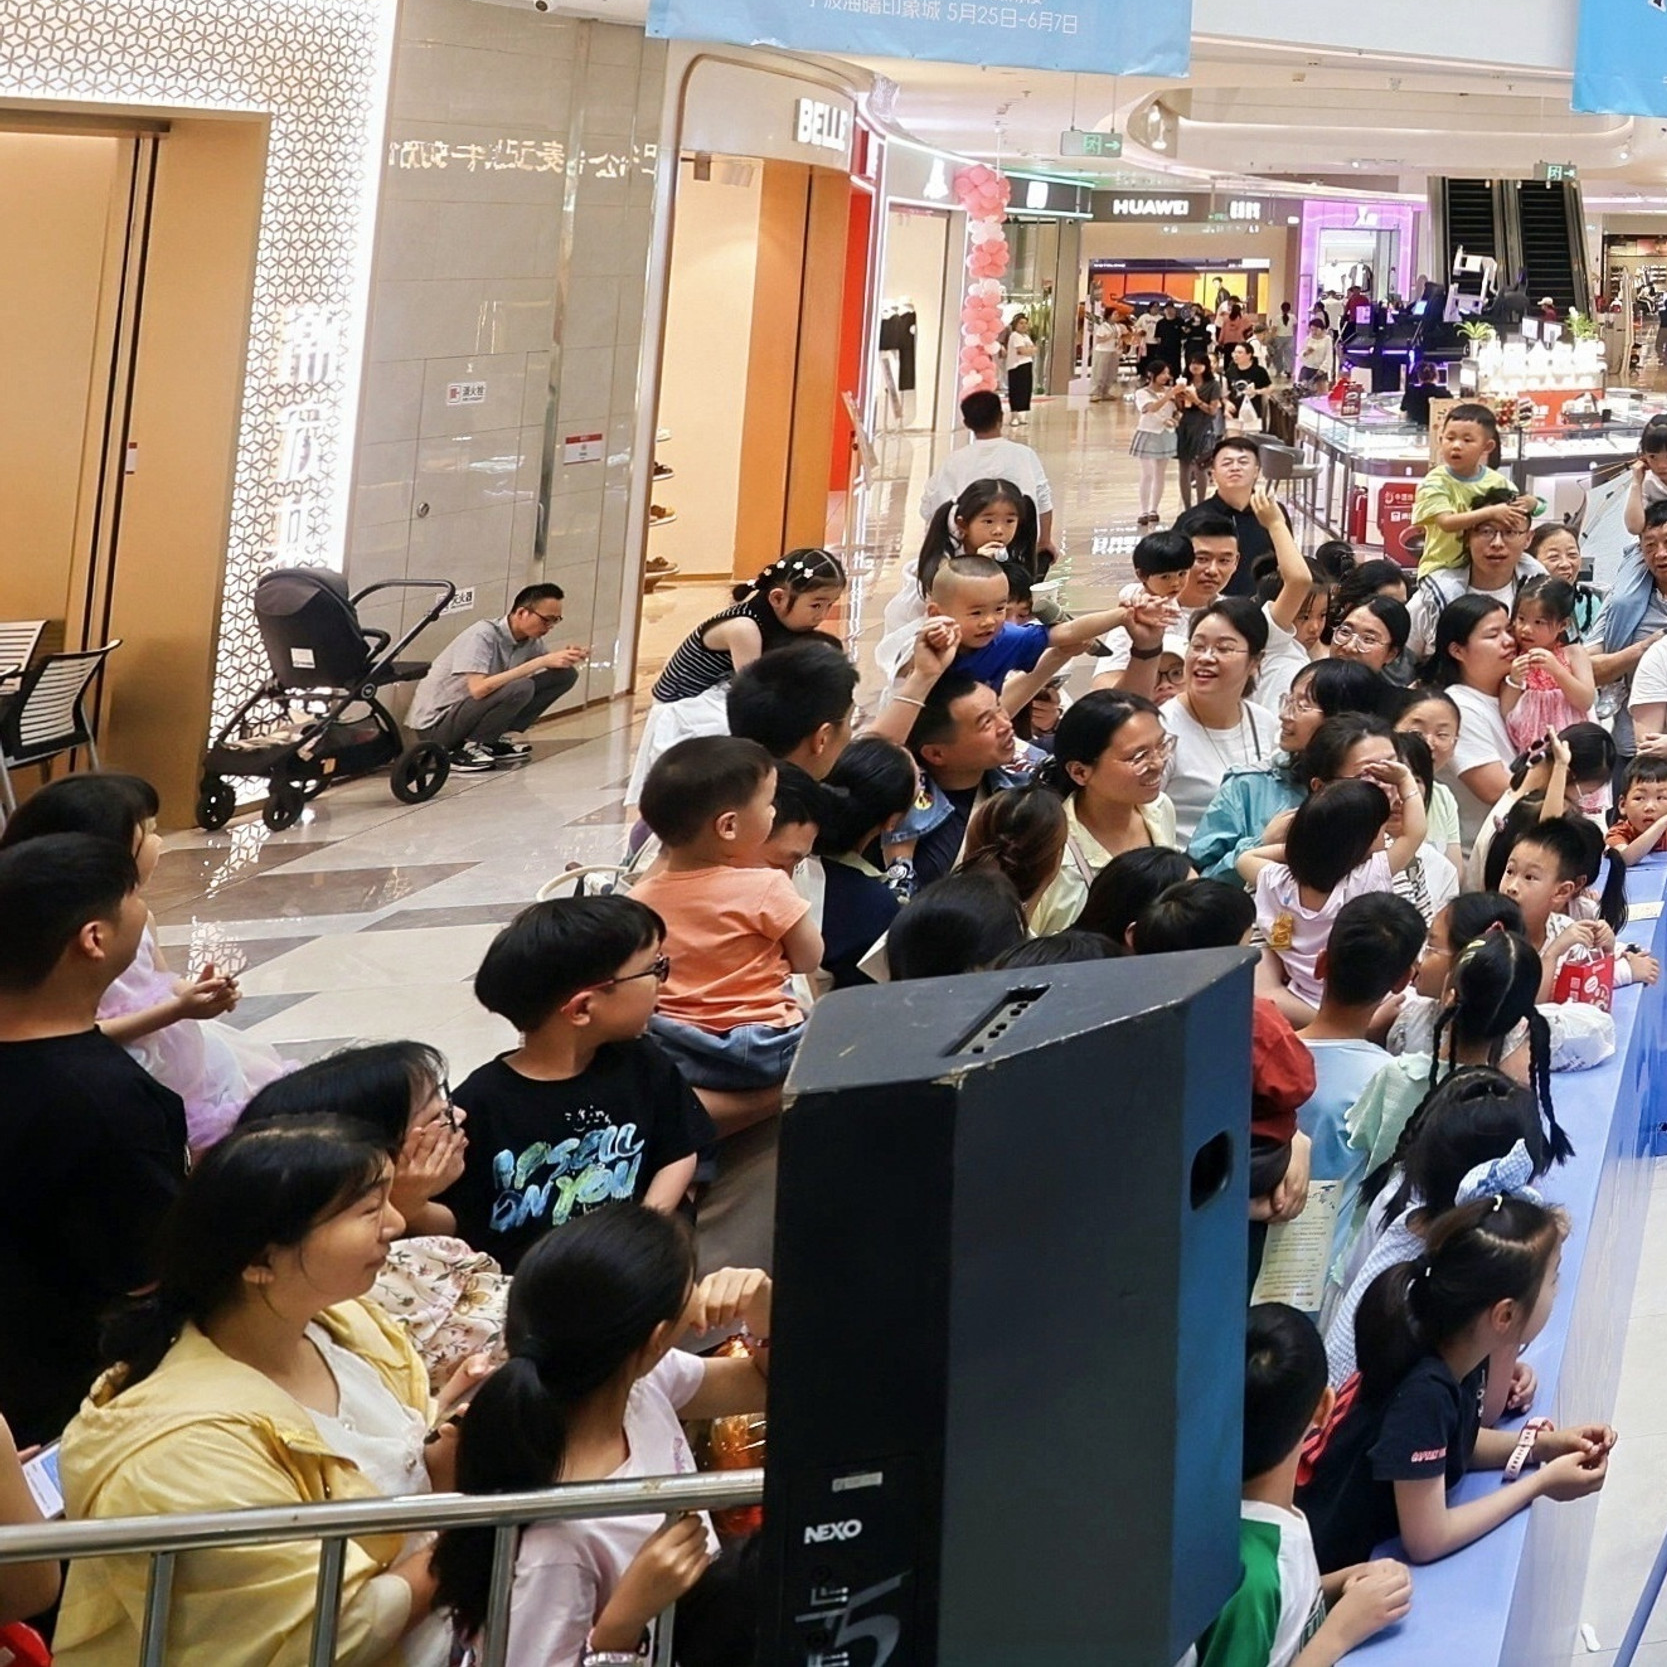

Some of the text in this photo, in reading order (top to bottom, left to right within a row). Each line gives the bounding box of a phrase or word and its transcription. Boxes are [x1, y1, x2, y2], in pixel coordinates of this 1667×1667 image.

[946, 0, 1079, 36] 5月25日-6月7日
[1112, 198, 1190, 216] HUAWEI
[803, 1518, 863, 1545] NEXO
